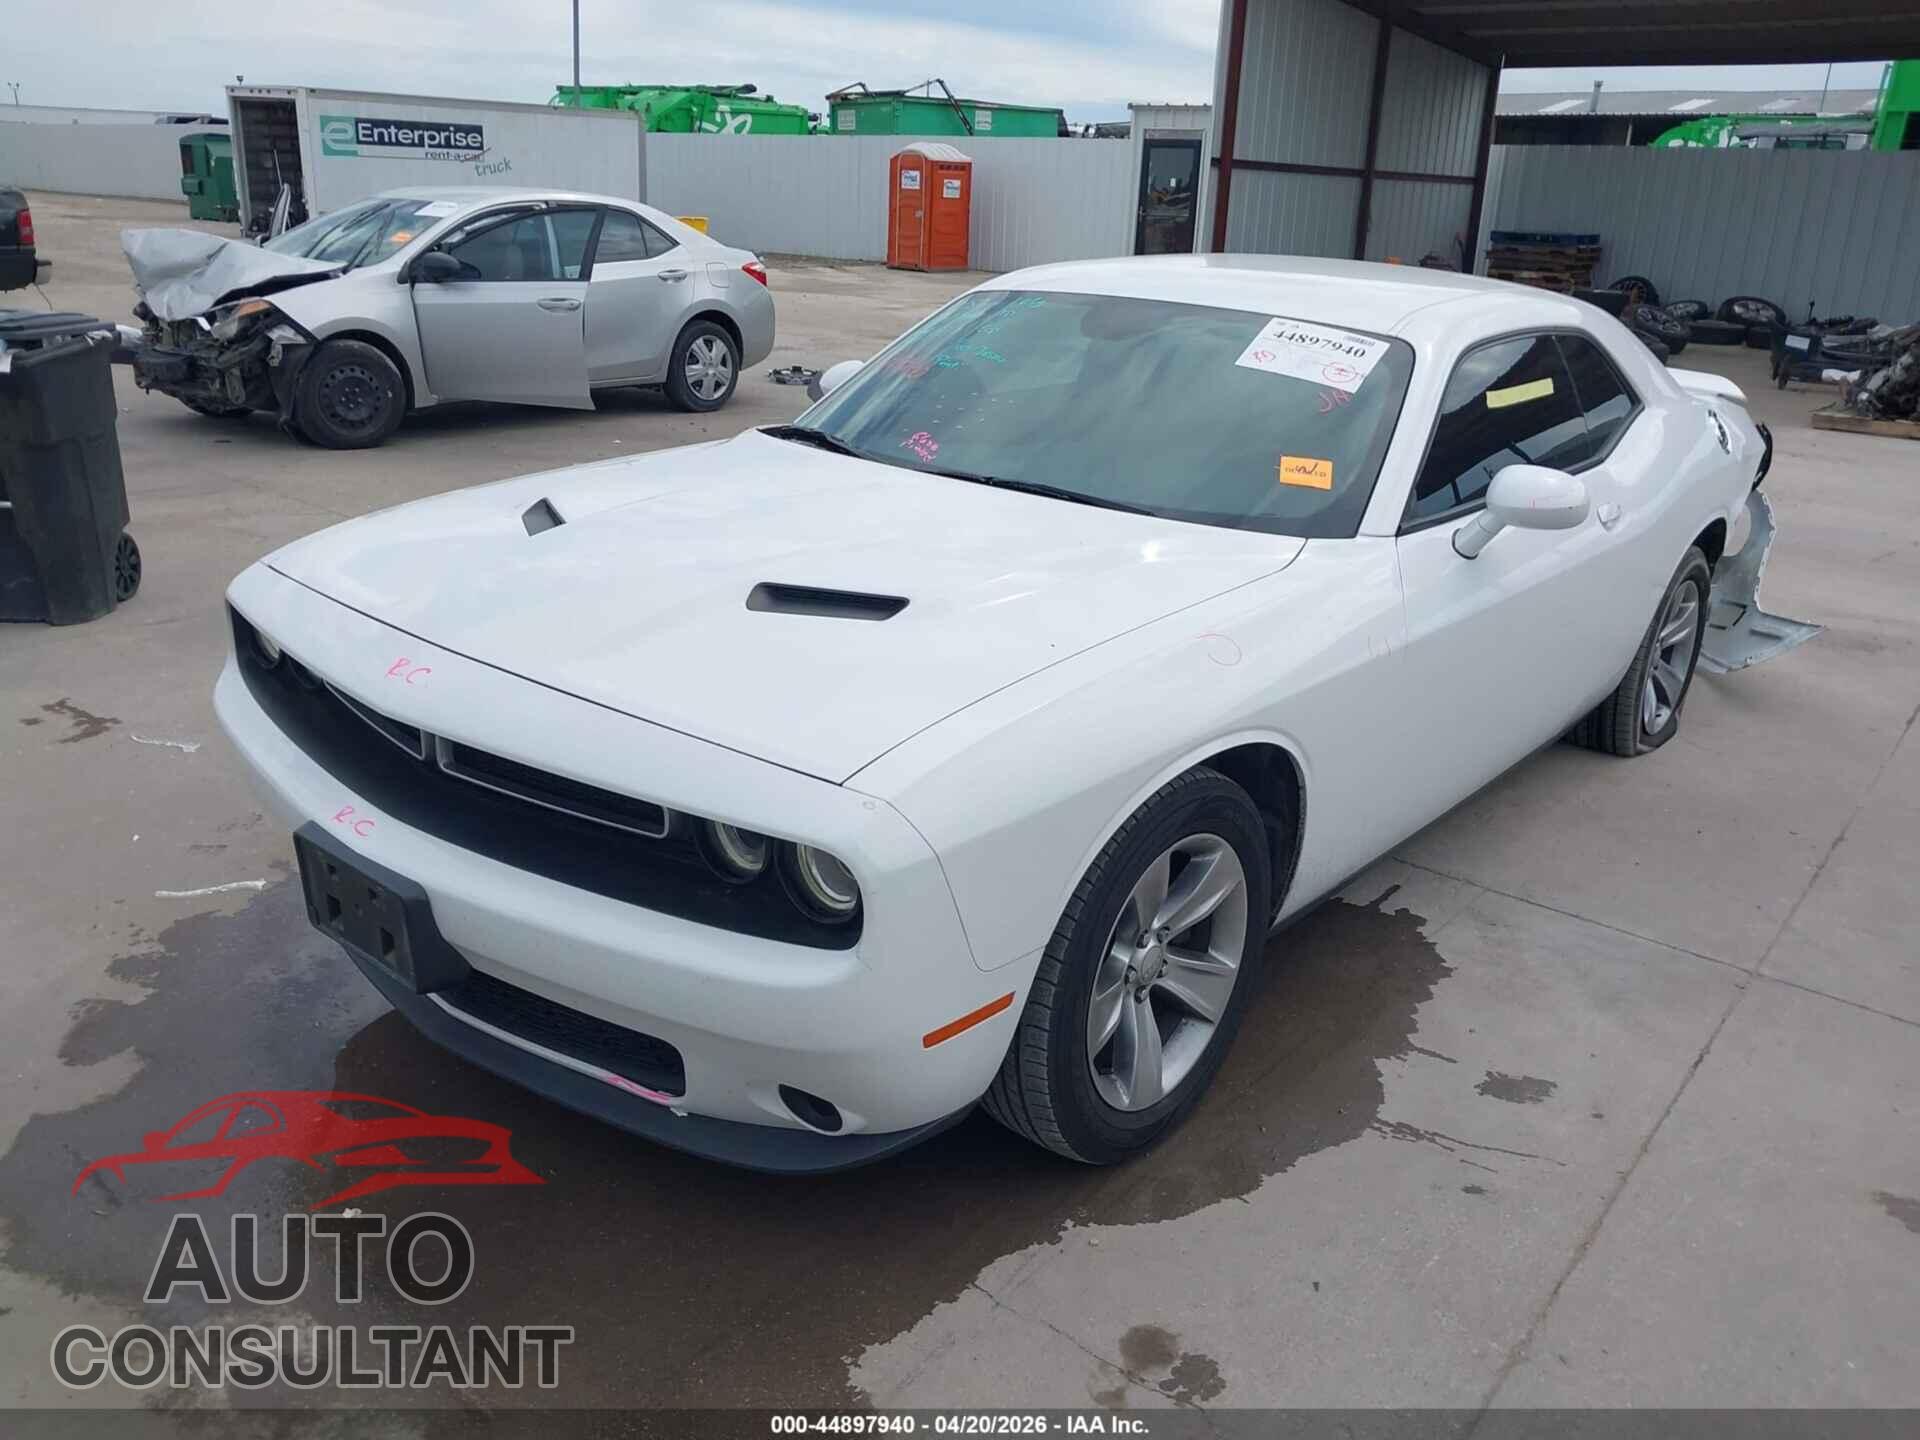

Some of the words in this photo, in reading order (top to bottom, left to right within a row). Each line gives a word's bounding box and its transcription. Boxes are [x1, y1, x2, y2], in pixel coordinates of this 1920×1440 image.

[356, 122, 483, 149] Enterprise
[474, 157, 512, 177] truck
[1273, 330, 1367, 359] 44897940
